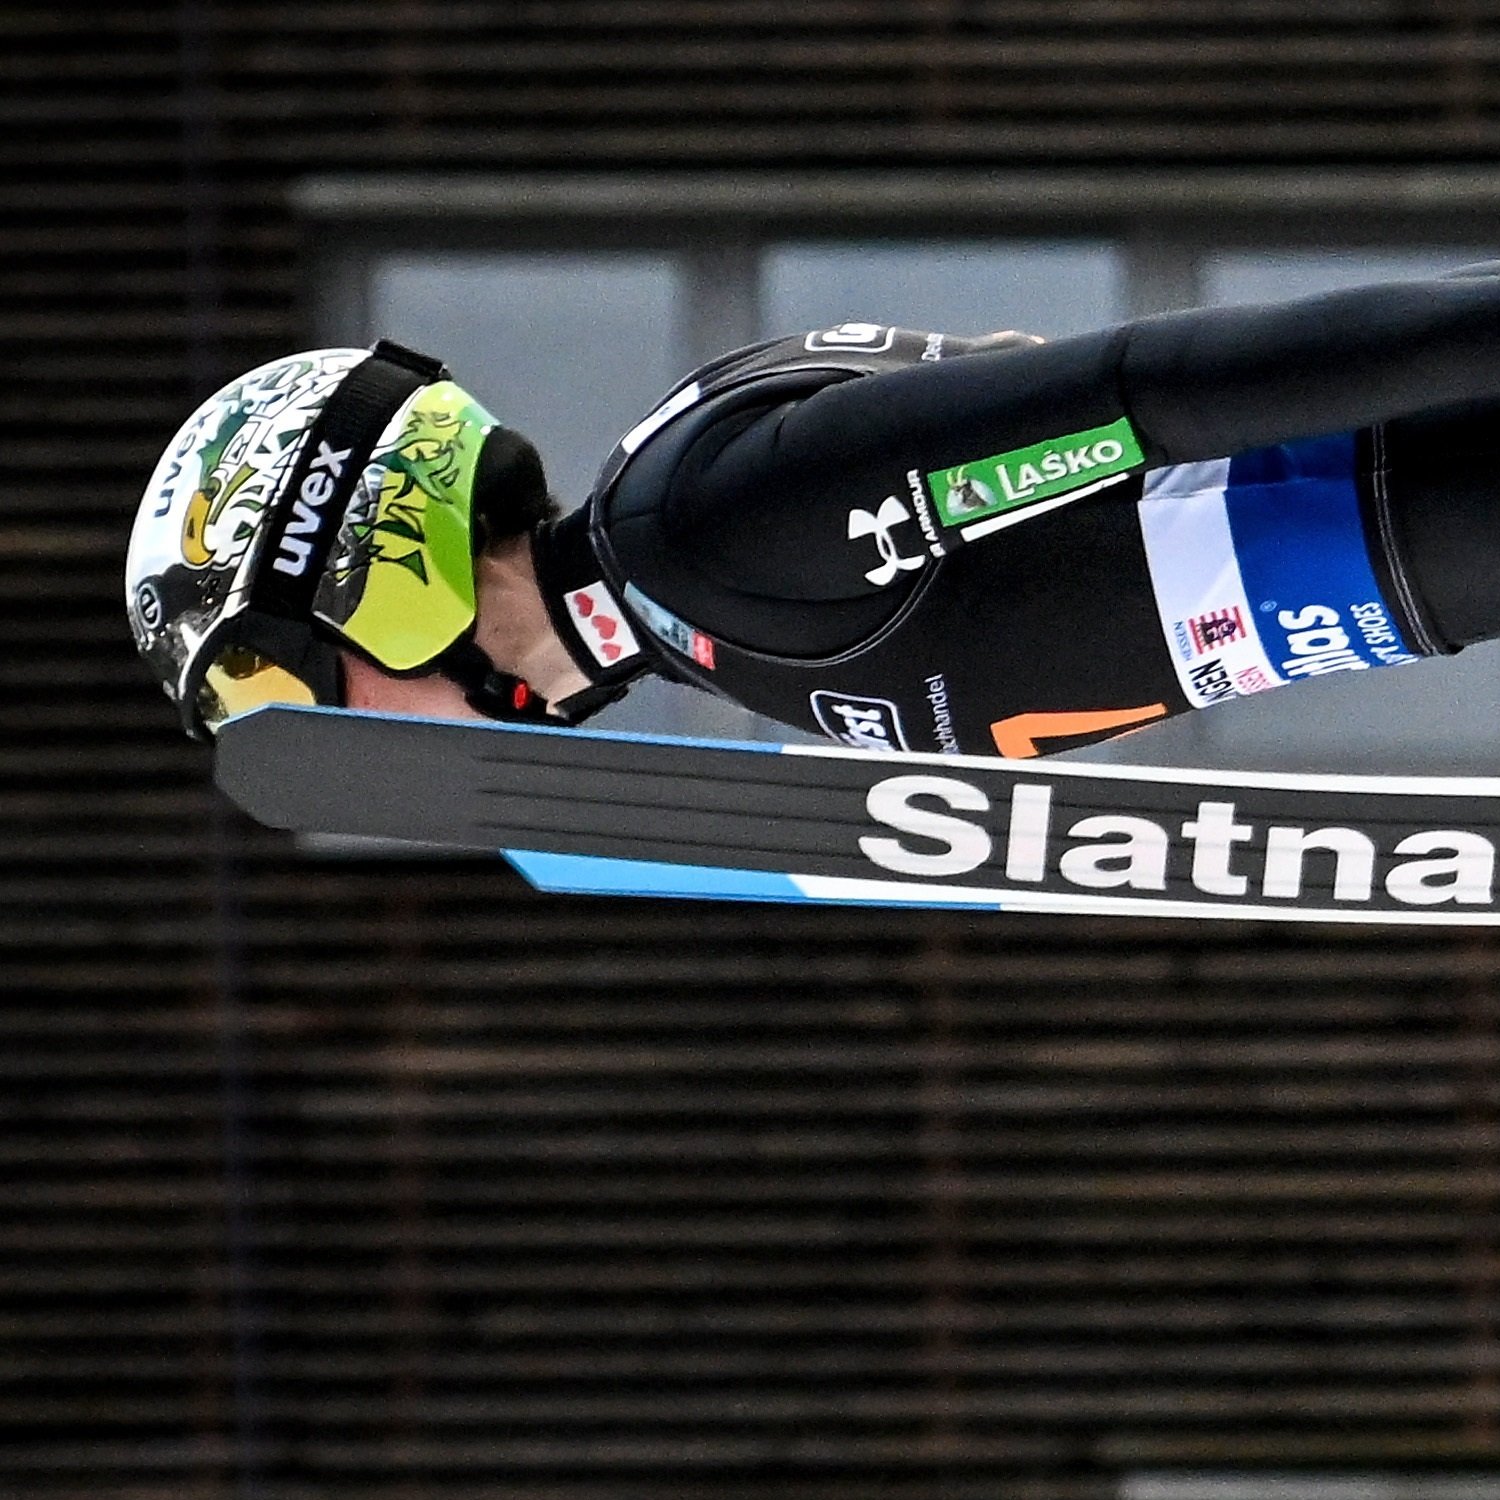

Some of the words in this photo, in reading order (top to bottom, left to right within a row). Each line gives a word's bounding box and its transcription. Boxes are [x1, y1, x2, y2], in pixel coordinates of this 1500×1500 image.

[152, 409, 214, 519] uvex
[273, 440, 353, 577] uvex
[1349, 602, 1396, 645] SHOES
